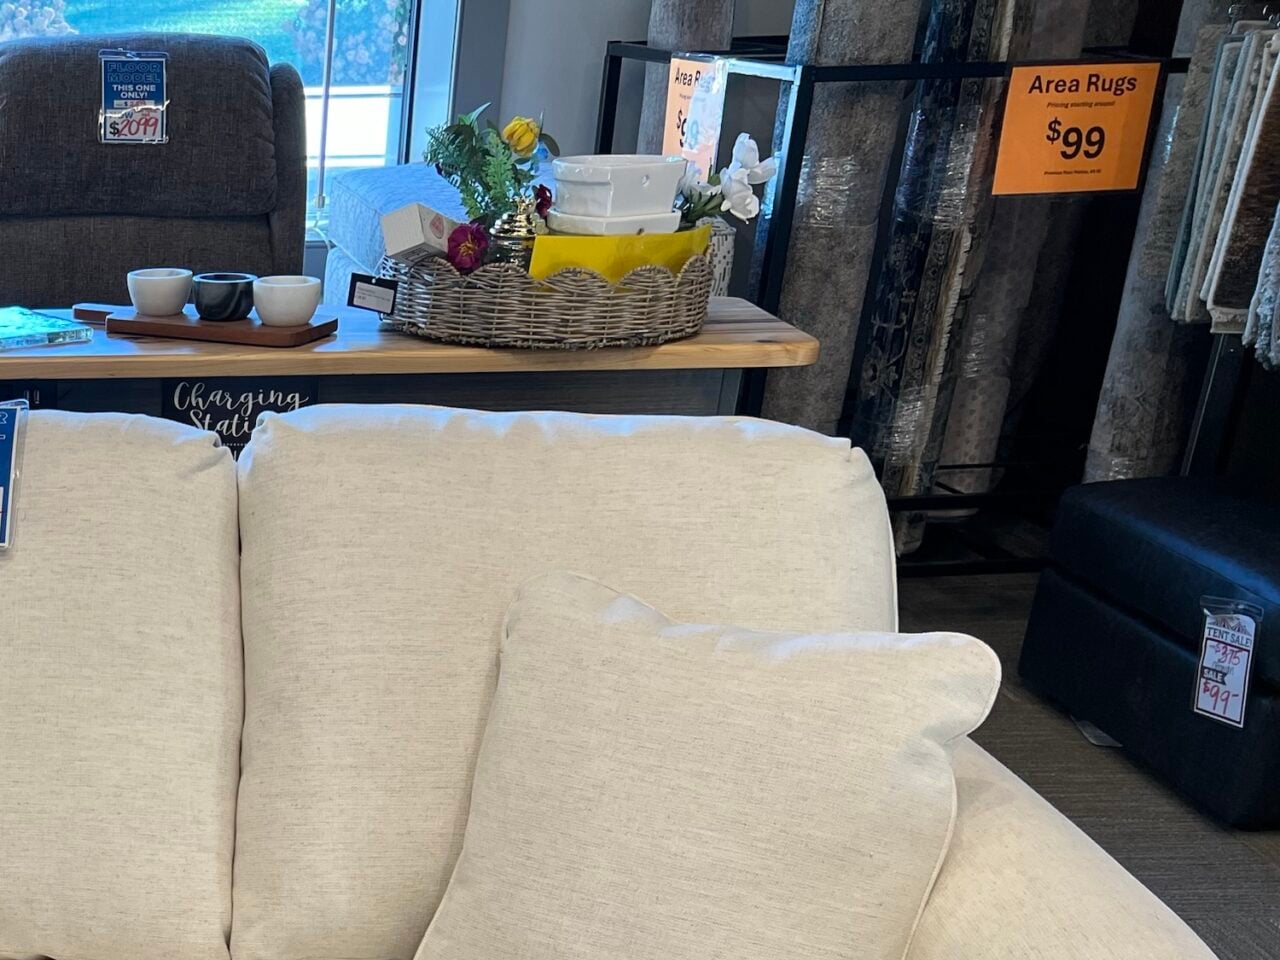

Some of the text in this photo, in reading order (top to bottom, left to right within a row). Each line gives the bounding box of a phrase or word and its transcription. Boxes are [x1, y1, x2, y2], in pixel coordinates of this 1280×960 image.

[107, 62, 160, 73] FLOOR
[107, 72, 161, 83] MODEL
[674, 67, 693, 87] Area
[1028, 74, 1137, 96] Area Rugs
[120, 91, 148, 99] ONLY!
[135, 84, 157, 92] ONE
[109, 117, 159, 137] $2099
[1046, 116, 1106, 160] $99
[174, 381, 309, 416] Charging
[190, 409, 253, 437] Stati
[1207, 627, 1231, 641] TENT
[1203, 668, 1223, 681] SALE
